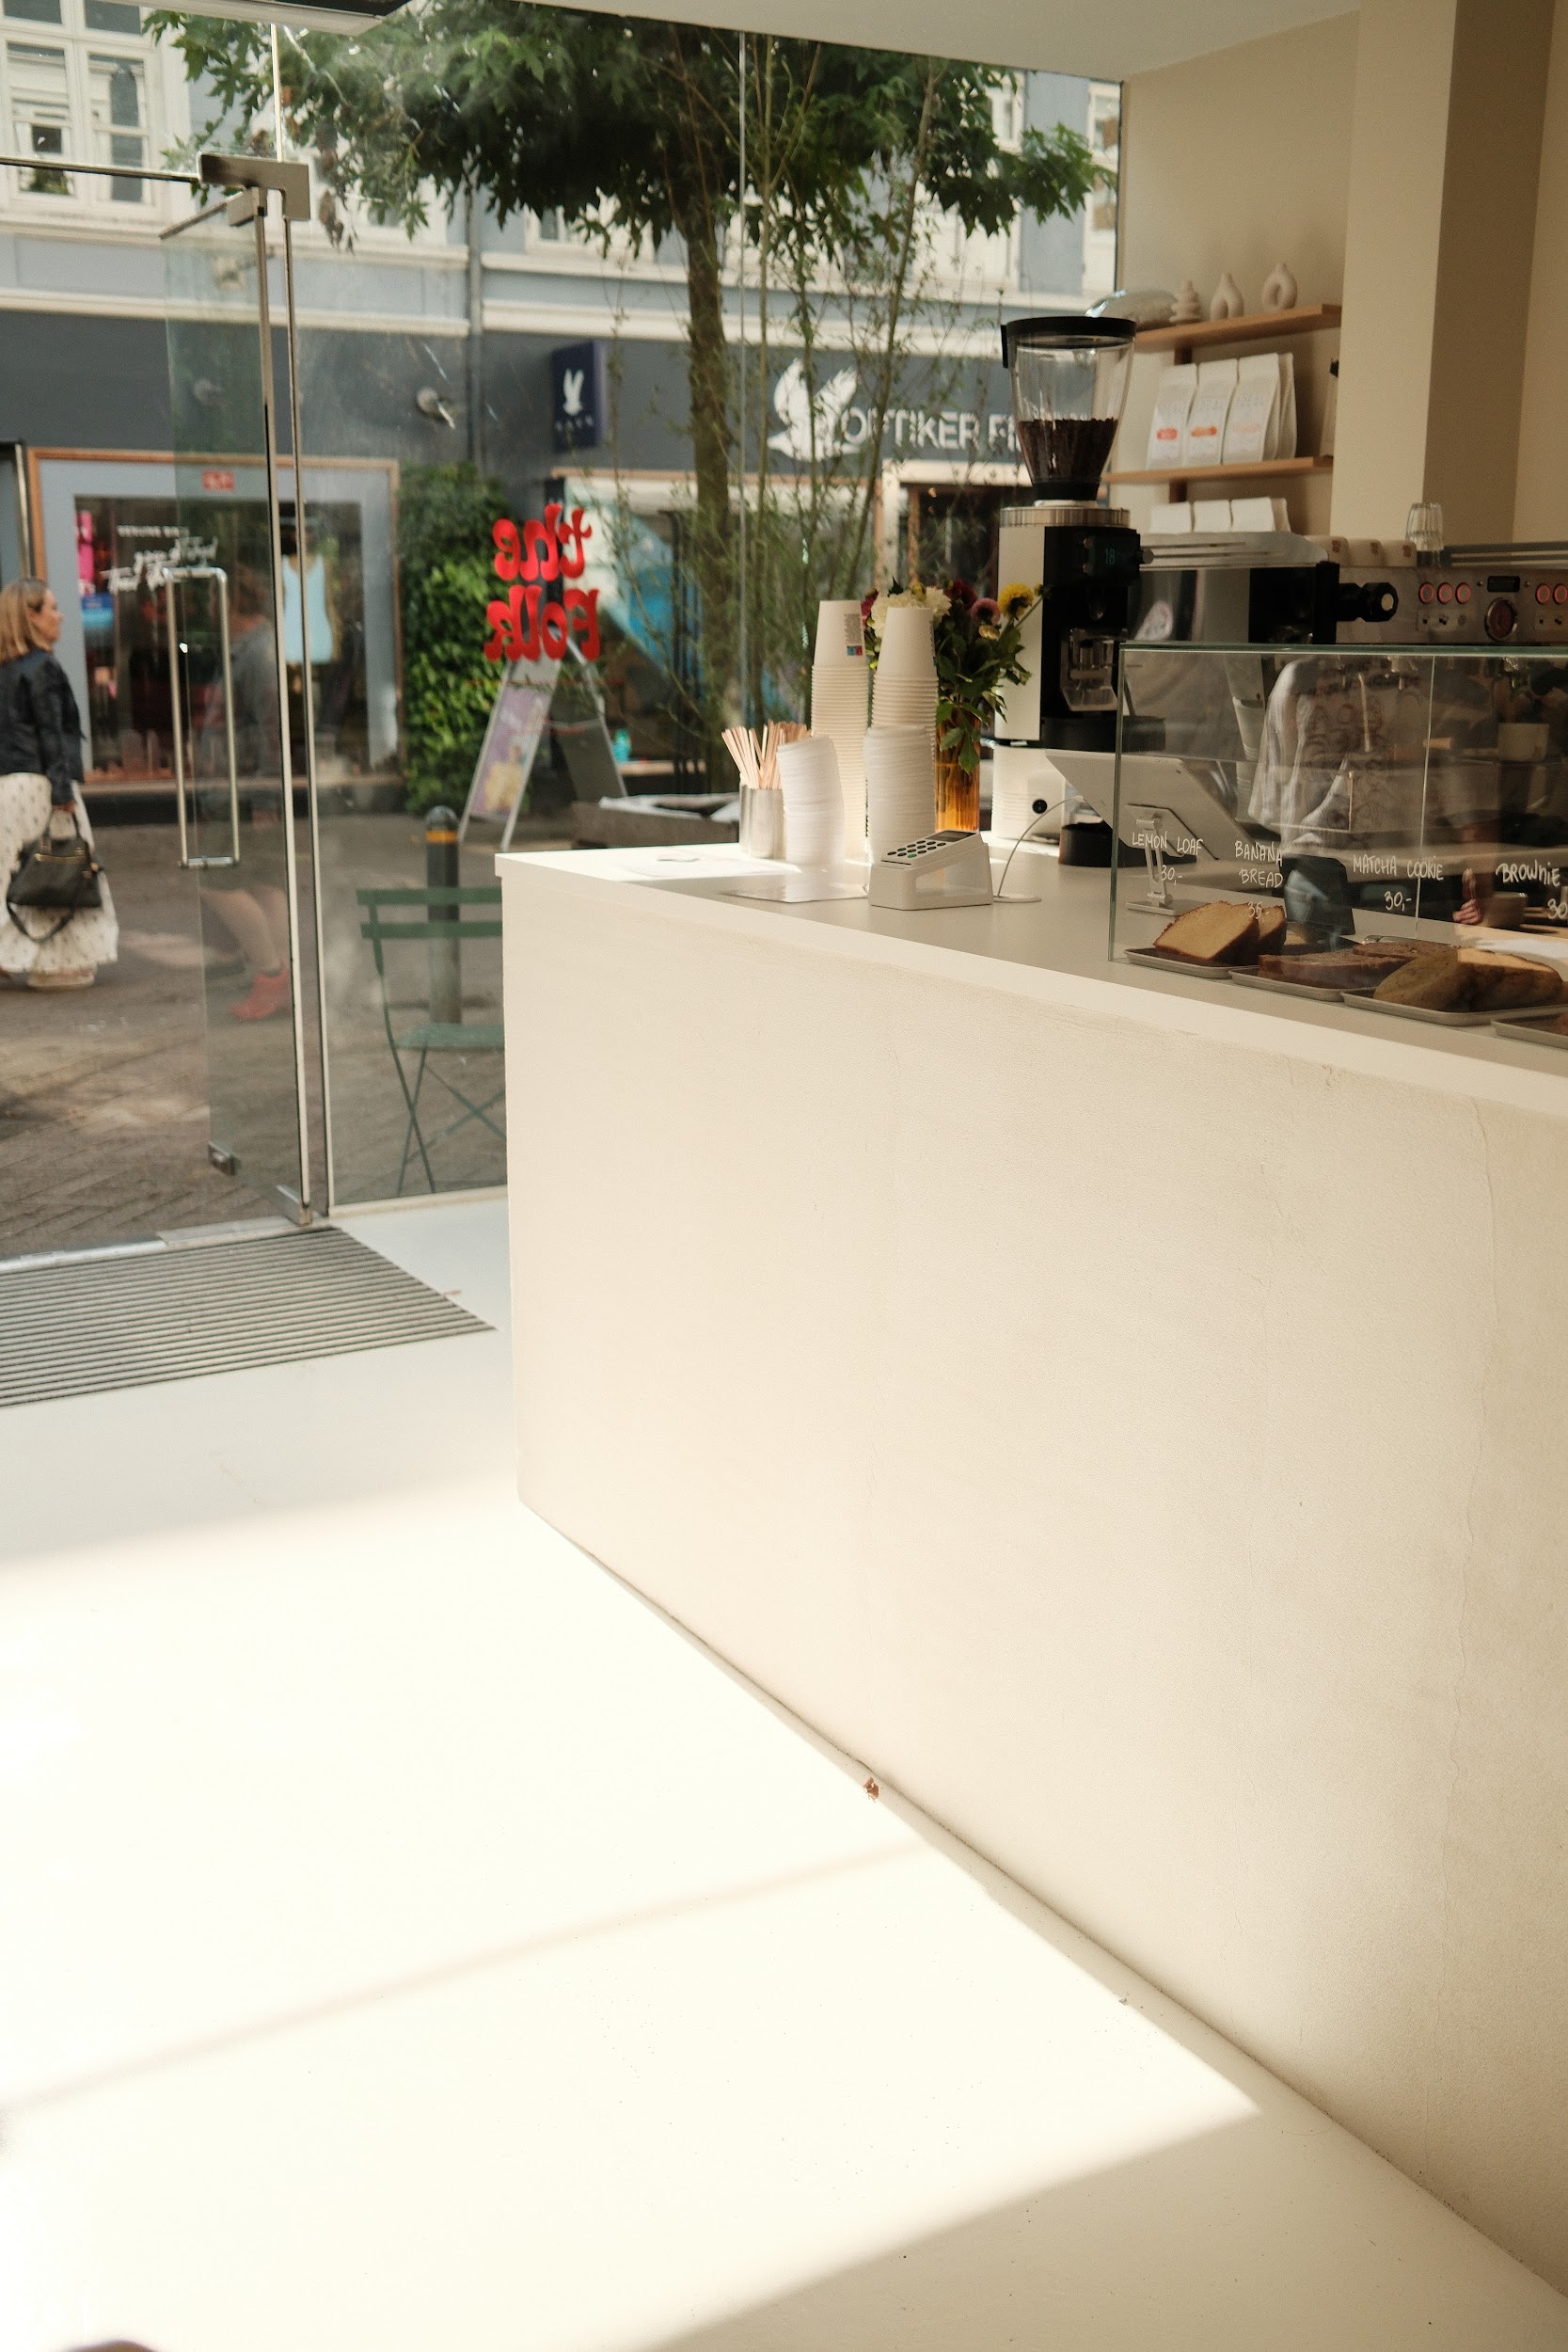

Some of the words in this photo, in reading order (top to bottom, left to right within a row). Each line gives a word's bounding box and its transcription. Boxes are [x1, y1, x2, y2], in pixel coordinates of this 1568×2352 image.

[1132, 831, 1168, 850] LEMON
[1177, 836, 1204, 856] LOAF
[1234, 840, 1283, 867] BANANA
[1353, 853, 1397, 877] MATCHA
[1239, 867, 1284, 889] BREAD
[1384, 890, 1413, 912] 30,-
